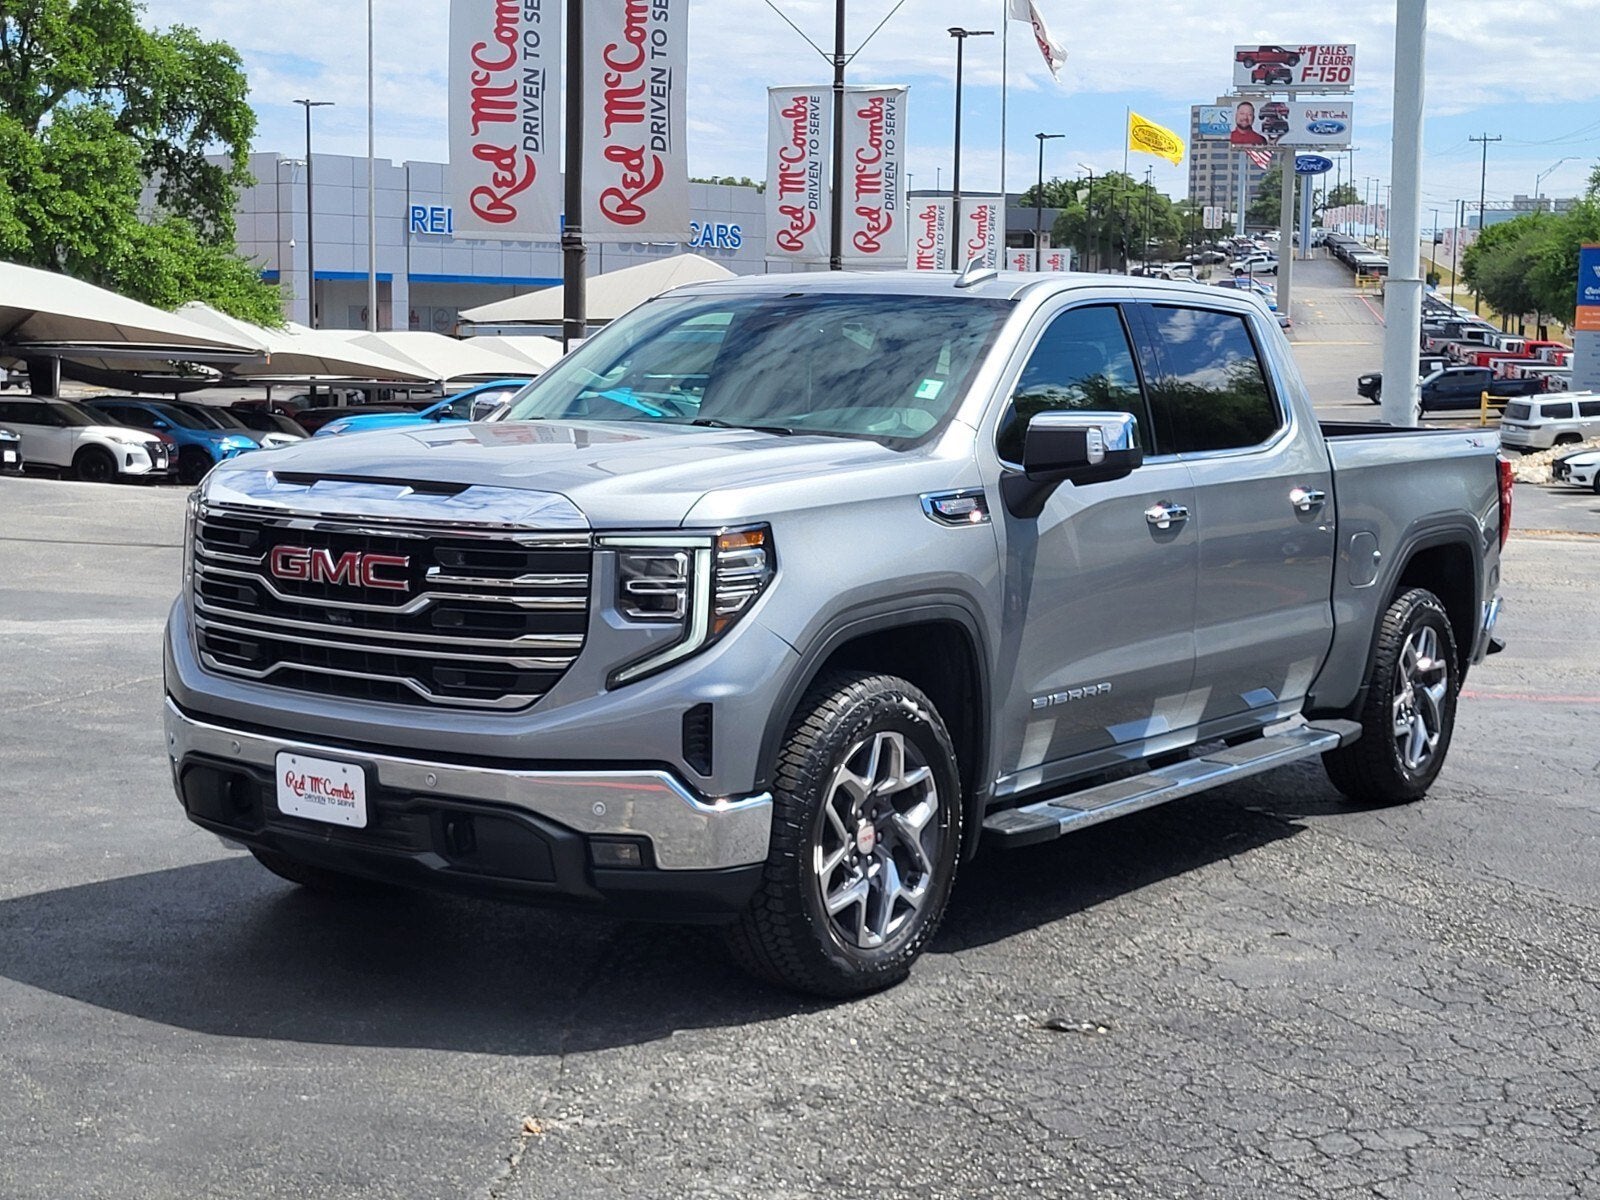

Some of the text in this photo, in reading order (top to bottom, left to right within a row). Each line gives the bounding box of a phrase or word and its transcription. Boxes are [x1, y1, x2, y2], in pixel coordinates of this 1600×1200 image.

[603, 0, 648, 138] McCom
[1316, 56, 1354, 66] LEADER
[1318, 45, 1348, 55] SALES
[523, 0, 541, 152] DRIVEN TO SE
[650, 0, 669, 152] DRIVEN TO SE
[1300, 66, 1352, 82] F-150
[470, 0, 537, 223] Red McCom
[776, 95, 816, 252] Red McCombs
[808, 95, 821, 210] DRIVEN TO SERVE
[853, 97, 893, 254] Red McCombs
[884, 97, 897, 211] DRIVEN TO SERVE
[1296, 158, 1324, 171] Ford
[599, 144, 664, 225] Red
[938, 204, 946, 232] SERVE
[988, 204, 997, 232] SERVE
[270, 545, 410, 592] GMC
[1031, 682, 1112, 710] SIERRA
[285, 770, 355, 801] Red McCombs
[304, 793, 355, 808] DRIVEN TO SERVE
